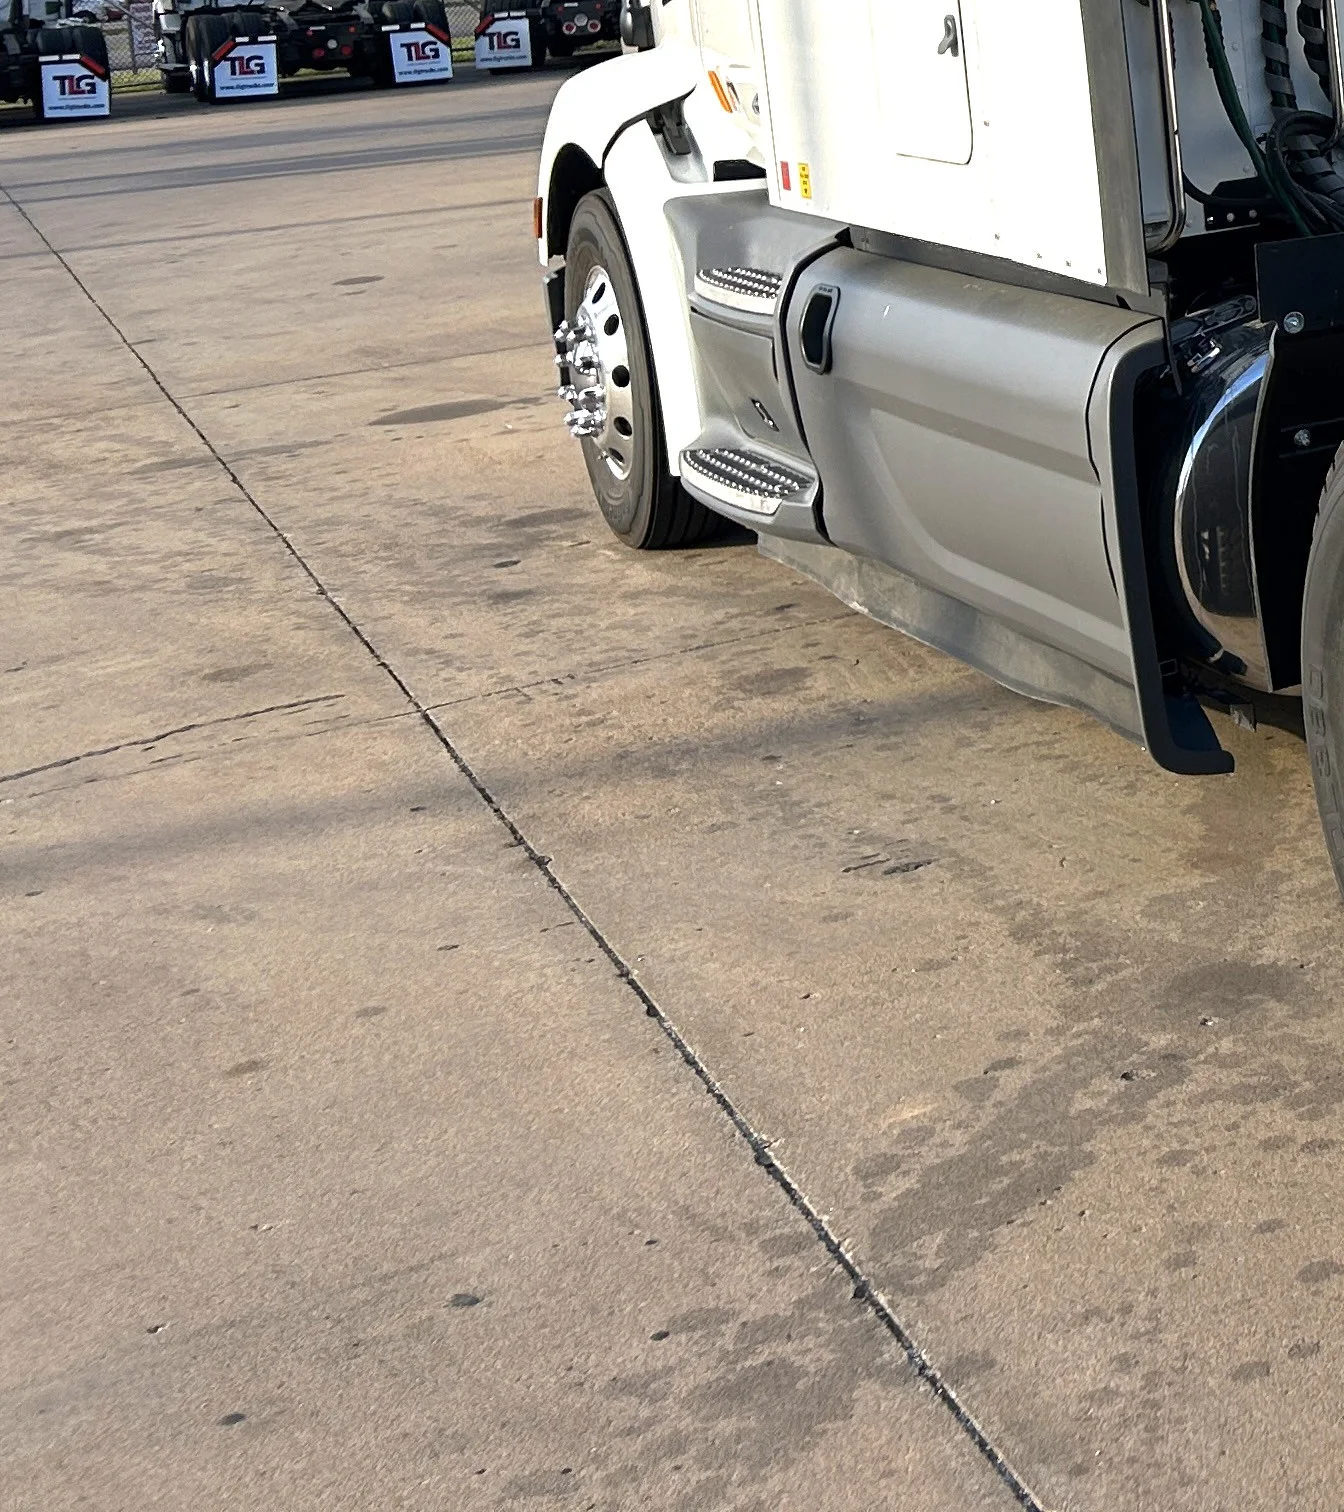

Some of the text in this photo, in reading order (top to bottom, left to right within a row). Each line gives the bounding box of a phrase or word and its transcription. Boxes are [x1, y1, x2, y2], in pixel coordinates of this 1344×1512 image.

[400, 40, 440, 61] TLG
[482, 31, 521, 50] TLG
[224, 54, 266, 76] TLG
[52, 74, 97, 95] TLG
